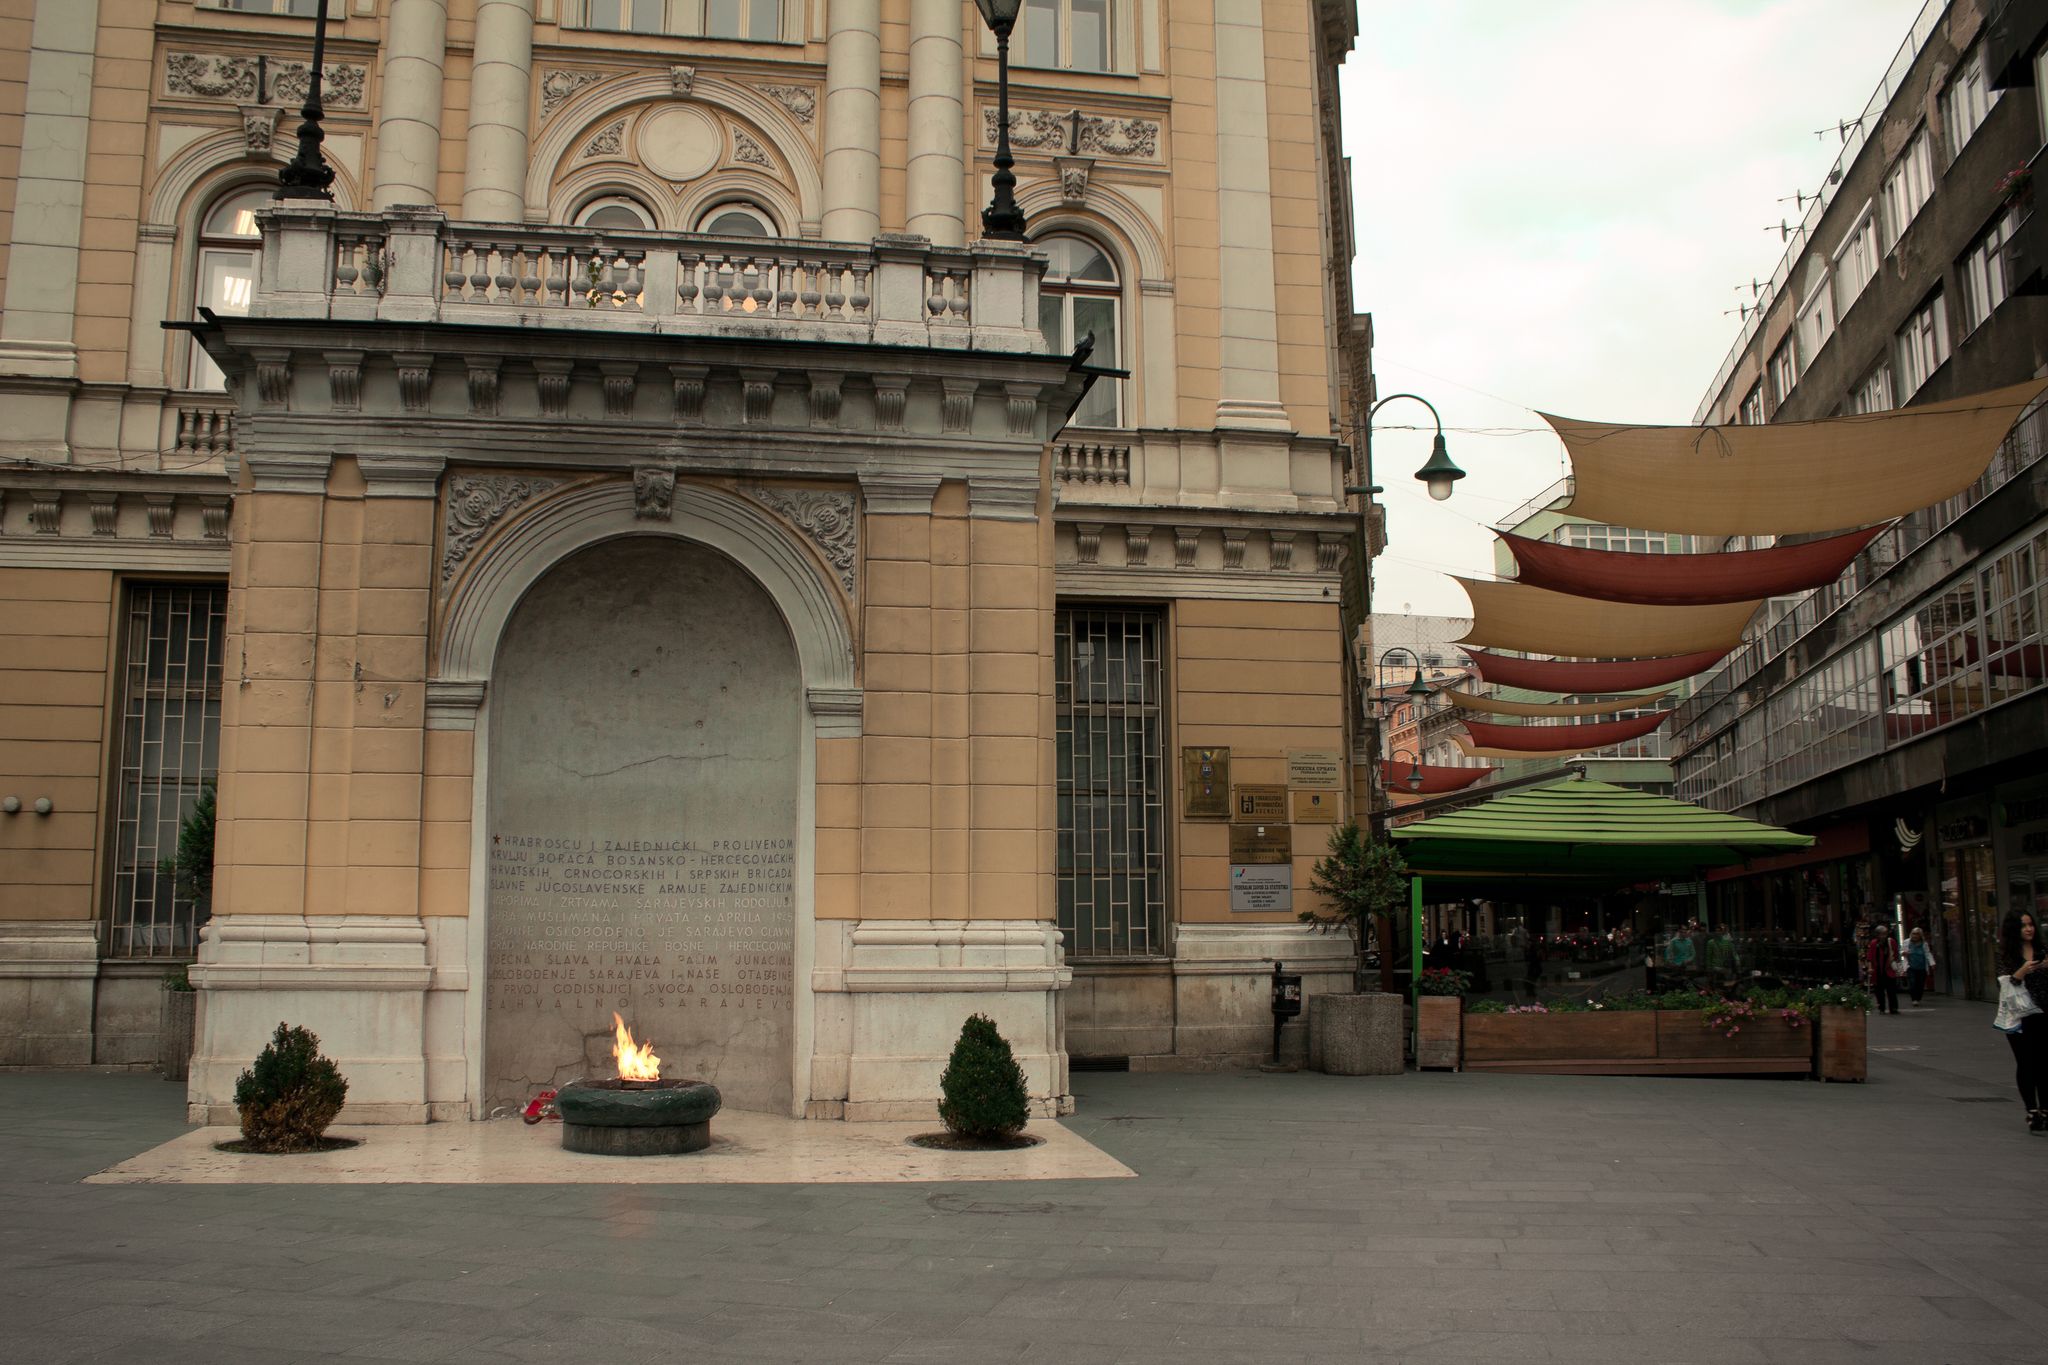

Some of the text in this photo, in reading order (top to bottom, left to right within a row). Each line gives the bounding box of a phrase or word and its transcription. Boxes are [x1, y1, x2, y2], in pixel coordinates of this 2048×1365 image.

[712, 839, 793, 850] PROLIVENOM
[538, 853, 595, 864] BORACA
[607, 855, 686, 866] BOSANSKO
[689, 869, 740, 880] SRPSKIH
[659, 883, 707, 895] ARMIJE
[635, 897, 726, 909] SARAJEVSKIH
[527, 911, 610, 923] MUSLIMANA
[703, 912, 712, 922] 6
[718, 911, 761, 922] APRILA
[657, 926, 675, 937] JE
[685, 926, 754, 938] SARAJEVO
[523, 940, 577, 952] NARODNE
[587, 940, 649, 953] REPUBLIKE
[665, 940, 704, 952] BOSNE
[735, 955, 792, 966] JUNACIMA
[588, 969, 660, 981] SARAJEVA
[504, 983, 540, 995] PRVOJ
